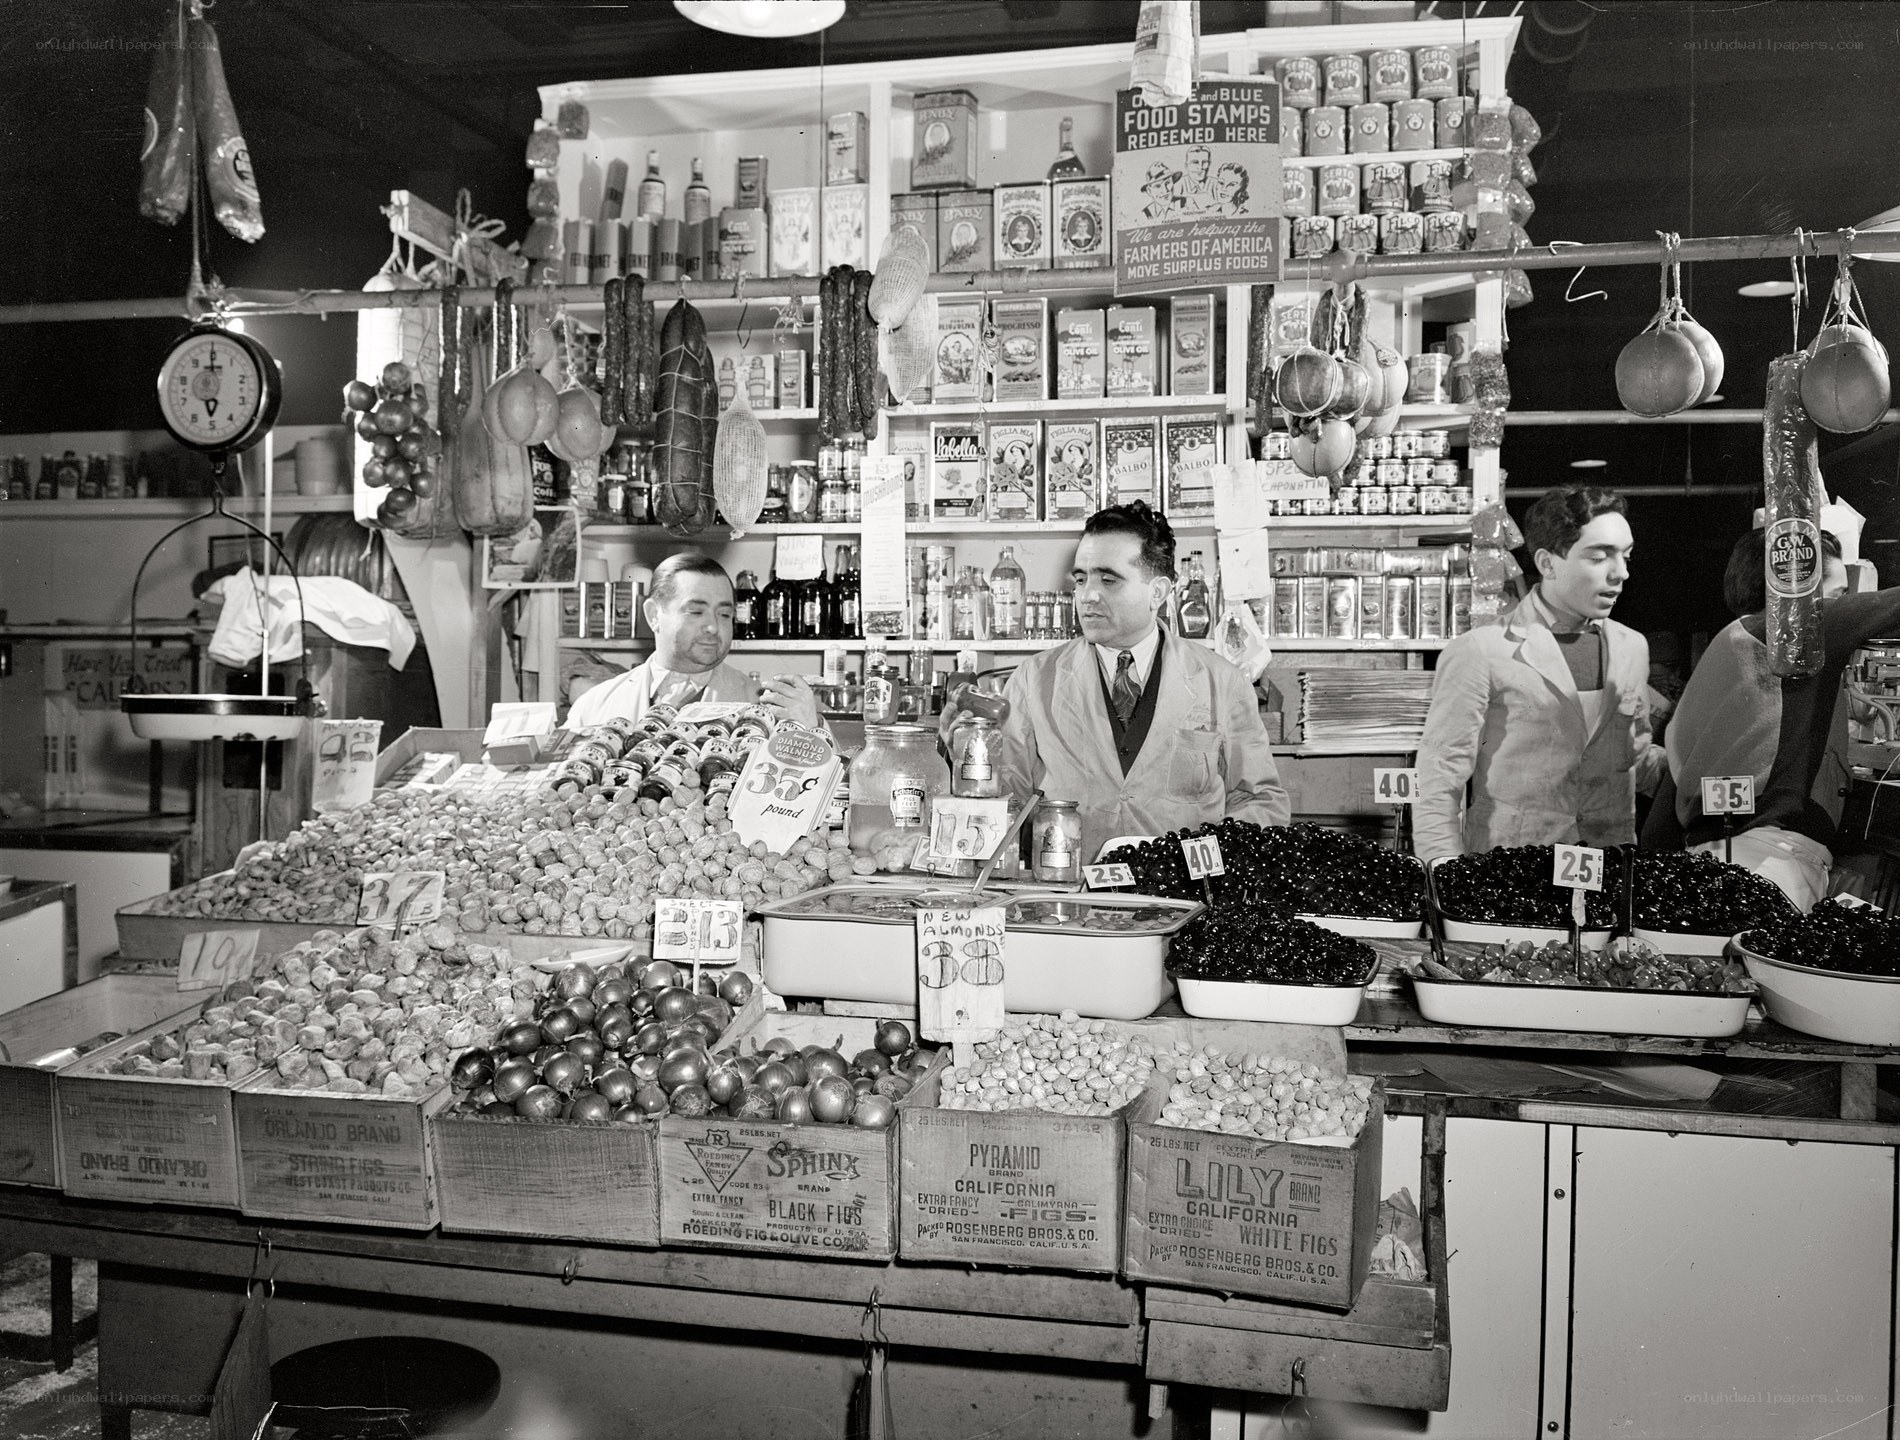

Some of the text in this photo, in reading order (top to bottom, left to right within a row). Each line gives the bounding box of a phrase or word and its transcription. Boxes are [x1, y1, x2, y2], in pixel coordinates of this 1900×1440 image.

[1201, 90, 1218, 101] and
[1220, 88, 1263, 102] BLUE
[1124, 104, 1271, 132] FOOD STAMPS
[1128, 127, 1267, 150] REDEEMED HERE
[1126, 221, 1266, 243] We are helping the
[1124, 236, 1273, 264] FARMERS OF AMERICA
[1127, 263, 1160, 279] MOVE
[1163, 257, 1222, 275] SURPLUS
[1114, 462, 1148, 475] BALBO
[1176, 459, 1211, 473] BALBO
[1771, 546, 1814, 563] BRAND
[775, 744, 823, 762] WALNUTS
[777, 736, 825, 754] DIAMOND
[1711, 782, 1743, 809] 35
[760, 803, 805, 819] pound
[1190, 843, 1213, 873] 40
[359, 875, 439, 922] 37
[923, 911, 971, 924] NEW
[923, 924, 1004, 938] ALMONDS
[917, 1115, 929, 1126] 25
[347, 1124, 401, 1144] BRAND
[711, 1133, 724, 1146] R
[1150, 1136, 1161, 1148] 25
[697, 1147, 742, 1161] ROEDING'S
[970, 1143, 1041, 1171] PYRAMID
[797, 1184, 831, 1192] BRAND
[954, 1179, 1056, 1197] CALIFORNIA
[1176, 1158, 1321, 1208] LILY BRAND
[692, 1192, 744, 1206] EXTRA FANCY
[917, 1193, 979, 1208] EXTRA FANCY
[1017, 1199, 1078, 1209] CALIMYRNA
[769, 1199, 862, 1226] BLACK FIGS
[928, 1206, 969, 1216] DRIED
[1009, 1208, 1087, 1222] FIGS
[1186, 1200, 1298, 1228] CALIFORNIA
[689, 1218, 727, 1227] PACKED
[766, 1222, 811, 1232] PRODUCTS
[1148, 1211, 1214, 1231] EXTRA CHOICE
[682, 1223, 742, 1239] ROEDING
[917, 1222, 944, 1238] PACKED
[929, 1231, 939, 1240] BY
[946, 1222, 1024, 1238] ROSENBERG
[1078, 1229, 1099, 1242] CO.
[1159, 1227, 1201, 1239] DRIED
[951, 1235, 970, 1243] SAN
[1239, 1224, 1338, 1257] WHITE FIGS
[1150, 1244, 1178, 1260] PACKED
[1161, 1253, 1172, 1262] BY
[1179, 1245, 1261, 1267] ROSENBERG
[1318, 1264, 1339, 1278] CO.
[1185, 1259, 1204, 1268] SAN
